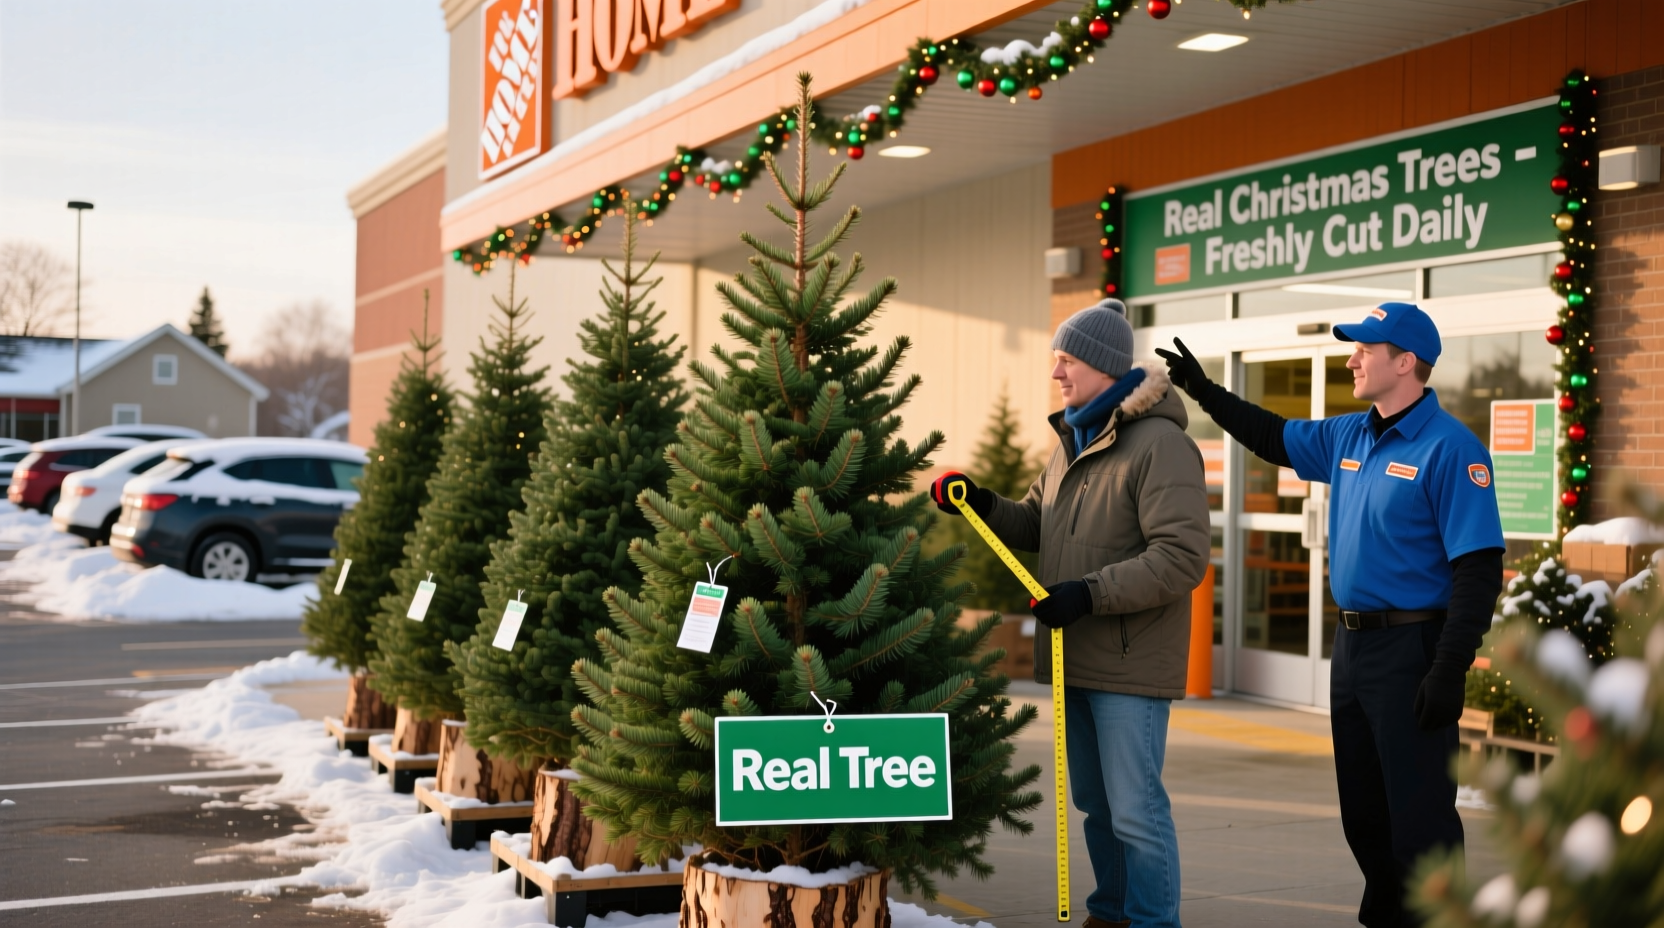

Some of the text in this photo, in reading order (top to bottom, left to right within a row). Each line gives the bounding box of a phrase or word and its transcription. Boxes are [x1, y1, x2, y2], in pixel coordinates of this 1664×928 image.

[1164, 188, 1223, 238] Real
[1229, 164, 1390, 226] Christmas
[1397, 143, 1502, 194] Trees
[1205, 222, 1315, 276] Freshly
[1322, 211, 1384, 258] Cut
[1392, 193, 1489, 250] Daily
[732, 746, 937, 792] Real Tree
